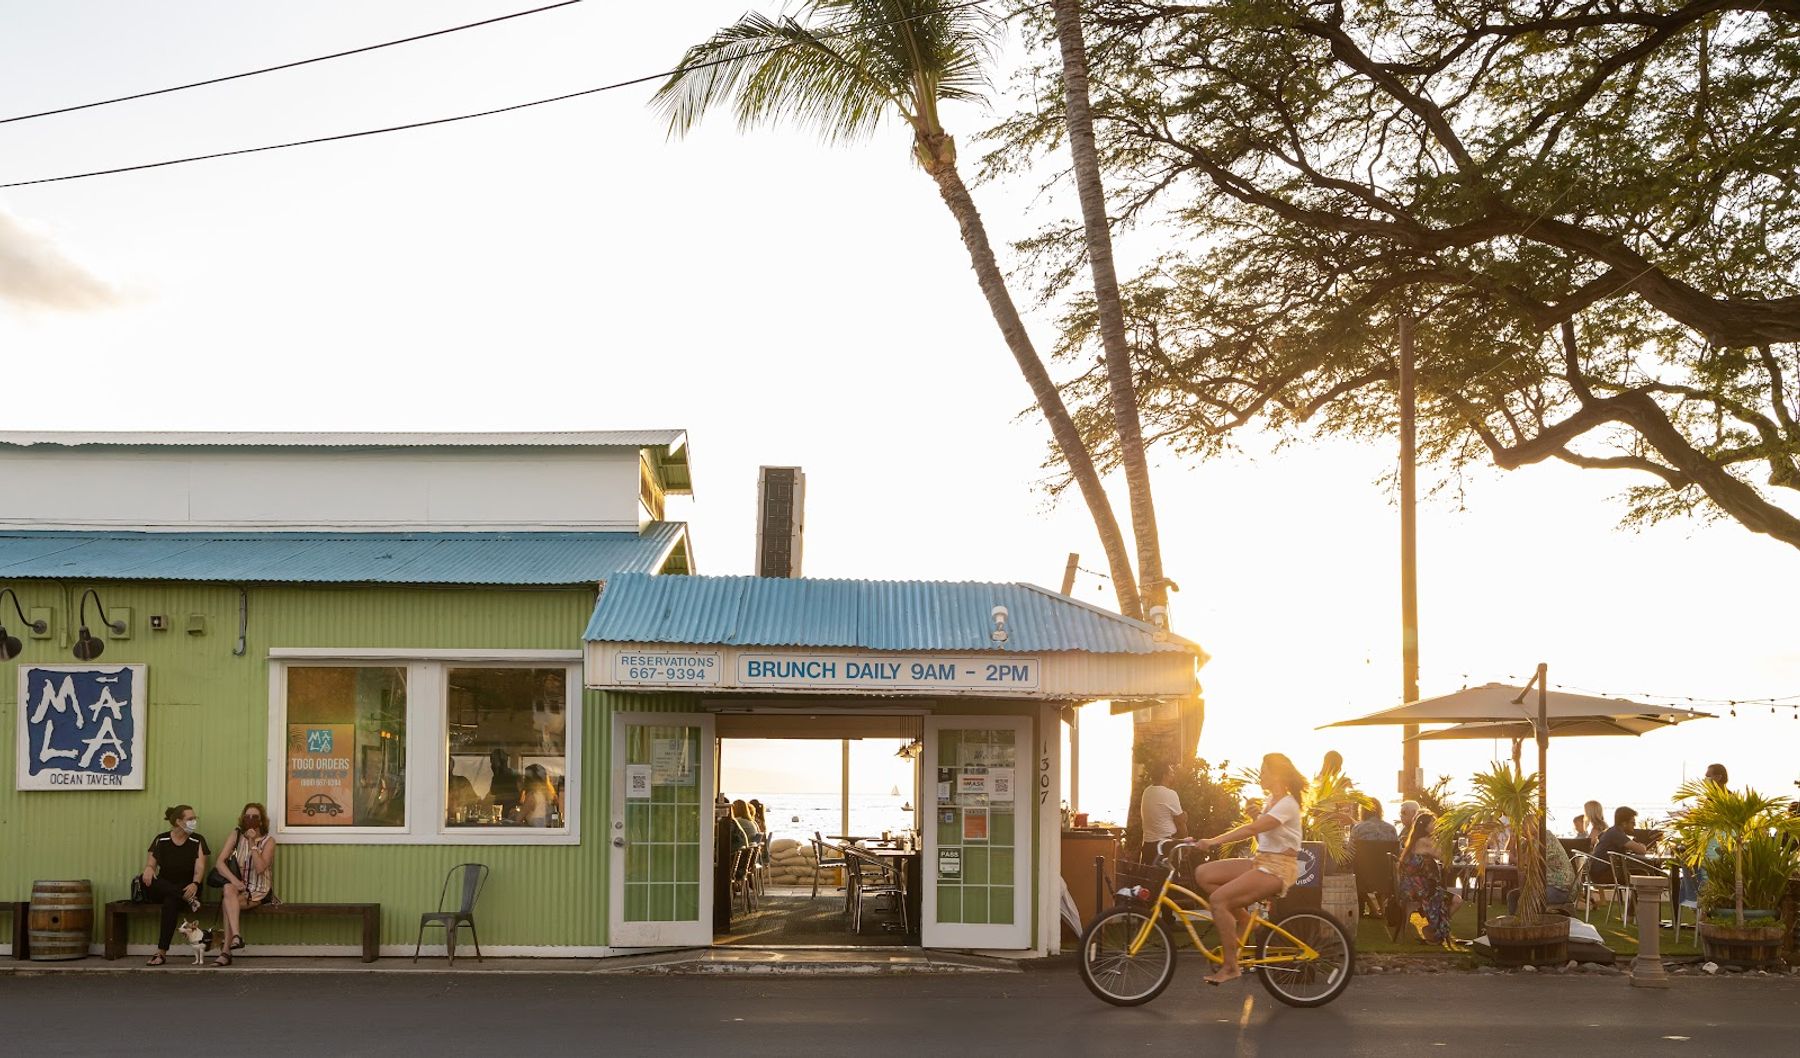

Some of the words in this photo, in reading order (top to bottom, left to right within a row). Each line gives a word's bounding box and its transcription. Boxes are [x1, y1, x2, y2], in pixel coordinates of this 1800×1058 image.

[621, 656, 714, 667] RESERVATIONS
[629, 668, 706, 680] 667-9394
[748, 660, 836, 678] BRUNCH
[846, 662, 901, 680] DAILY
[911, 663, 955, 680] 9AM
[986, 664, 1029, 681] 2PM
[292, 759, 314, 770] TOGO
[316, 759, 349, 770] ORDERS
[1040, 739, 1050, 805] 1307
[50, 773, 83, 785] OCEAN
[86, 774, 123, 786] TAVERN
